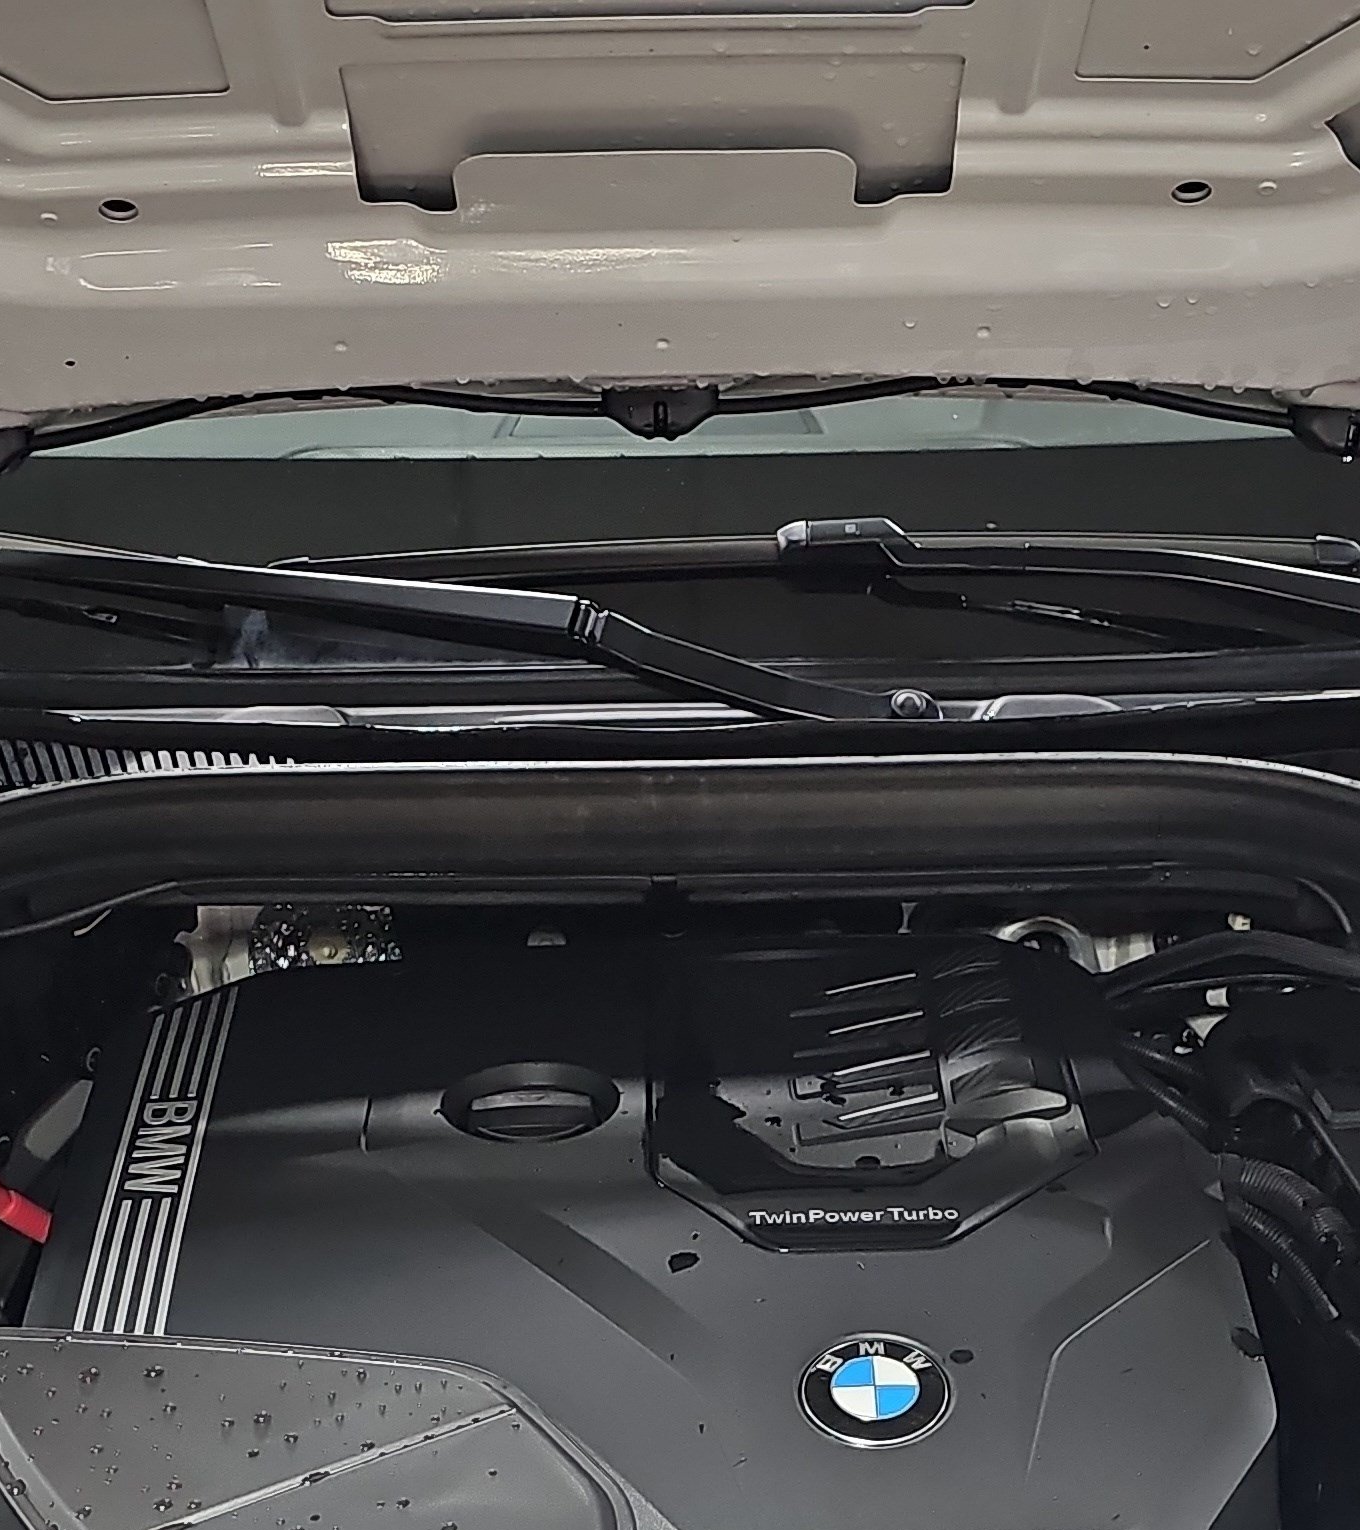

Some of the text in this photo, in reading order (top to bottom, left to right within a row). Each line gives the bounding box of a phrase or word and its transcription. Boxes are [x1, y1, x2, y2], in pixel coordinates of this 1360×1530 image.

[124, 1100, 198, 1193] BMW
[887, 1207, 959, 1221] Turbo
[816, 1341, 933, 1373] BMW
